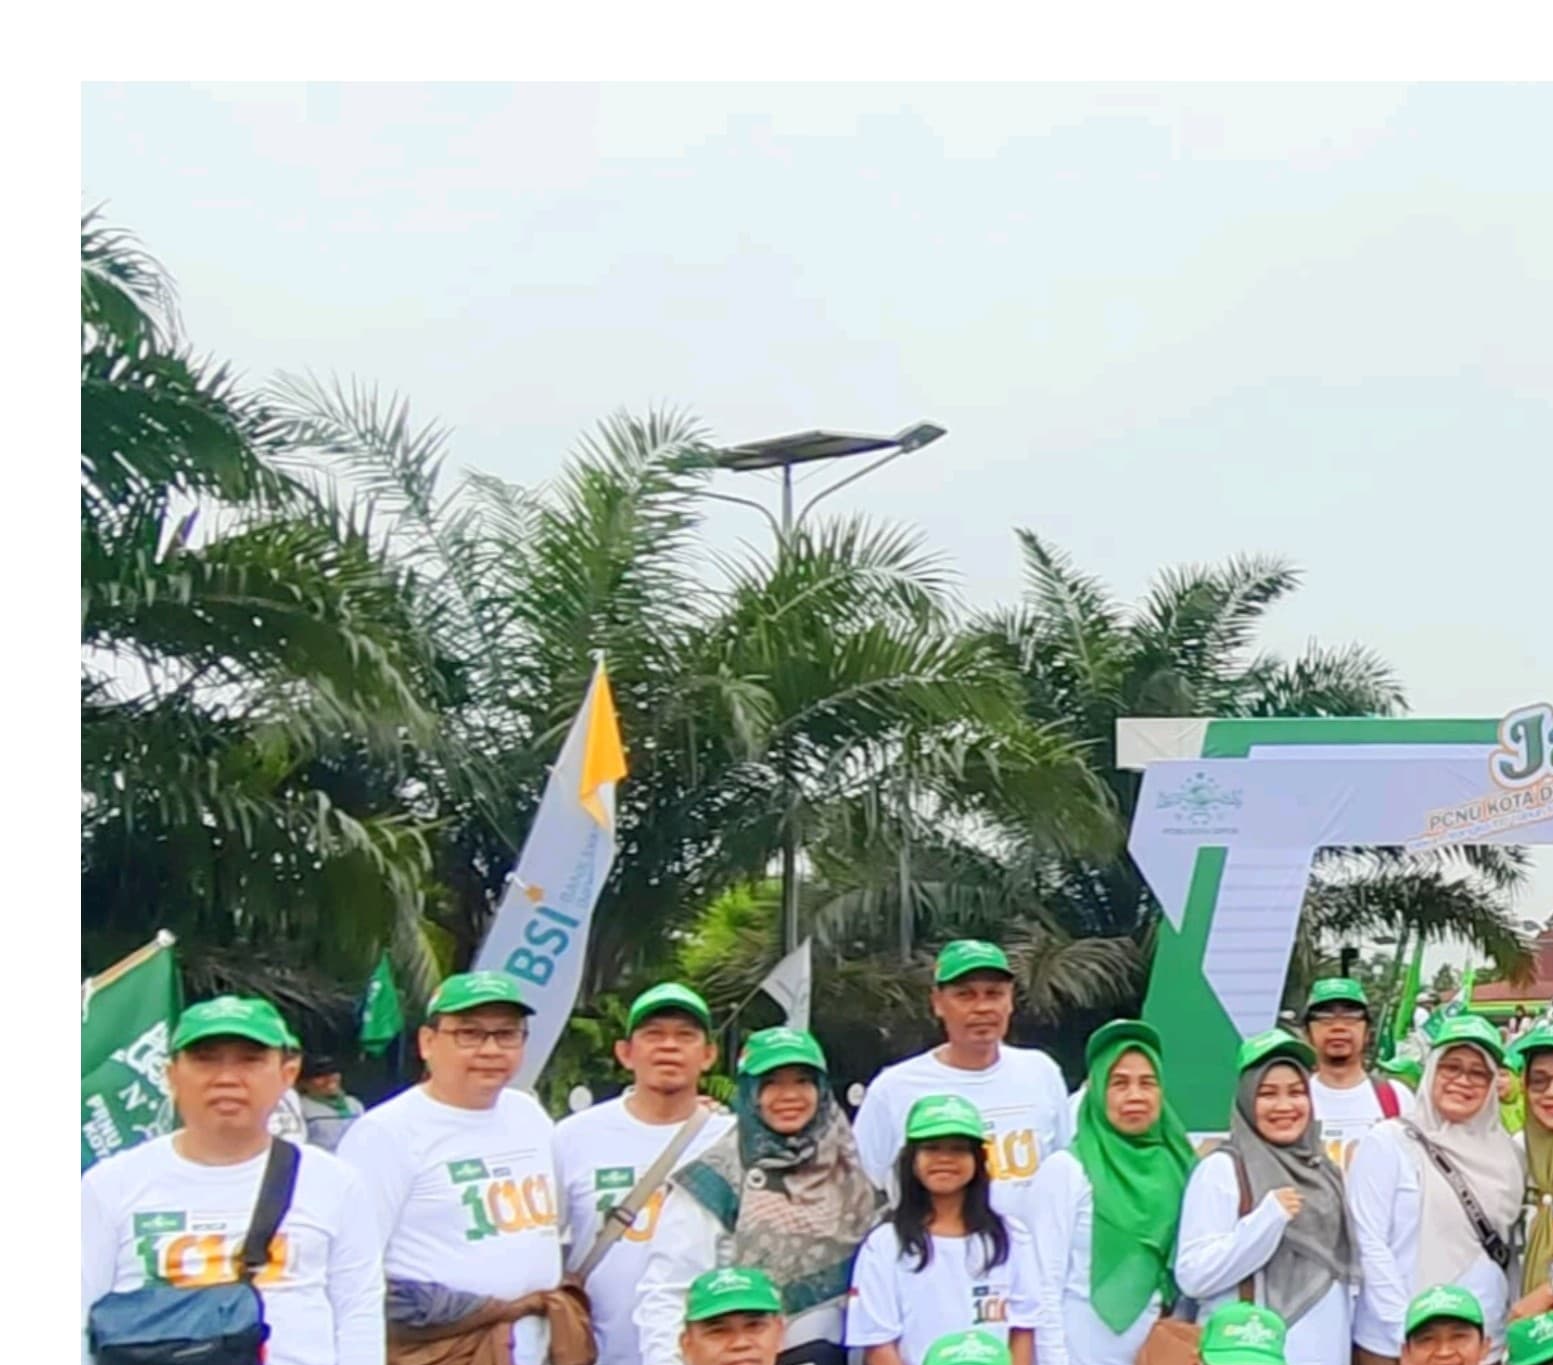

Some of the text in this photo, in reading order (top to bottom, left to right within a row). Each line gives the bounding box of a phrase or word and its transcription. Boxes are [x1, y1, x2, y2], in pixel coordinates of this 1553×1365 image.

[1429, 804, 1482, 831] PCNU
[1487, 791, 1534, 815] KOTA
[503, 906, 581, 987] BSI
